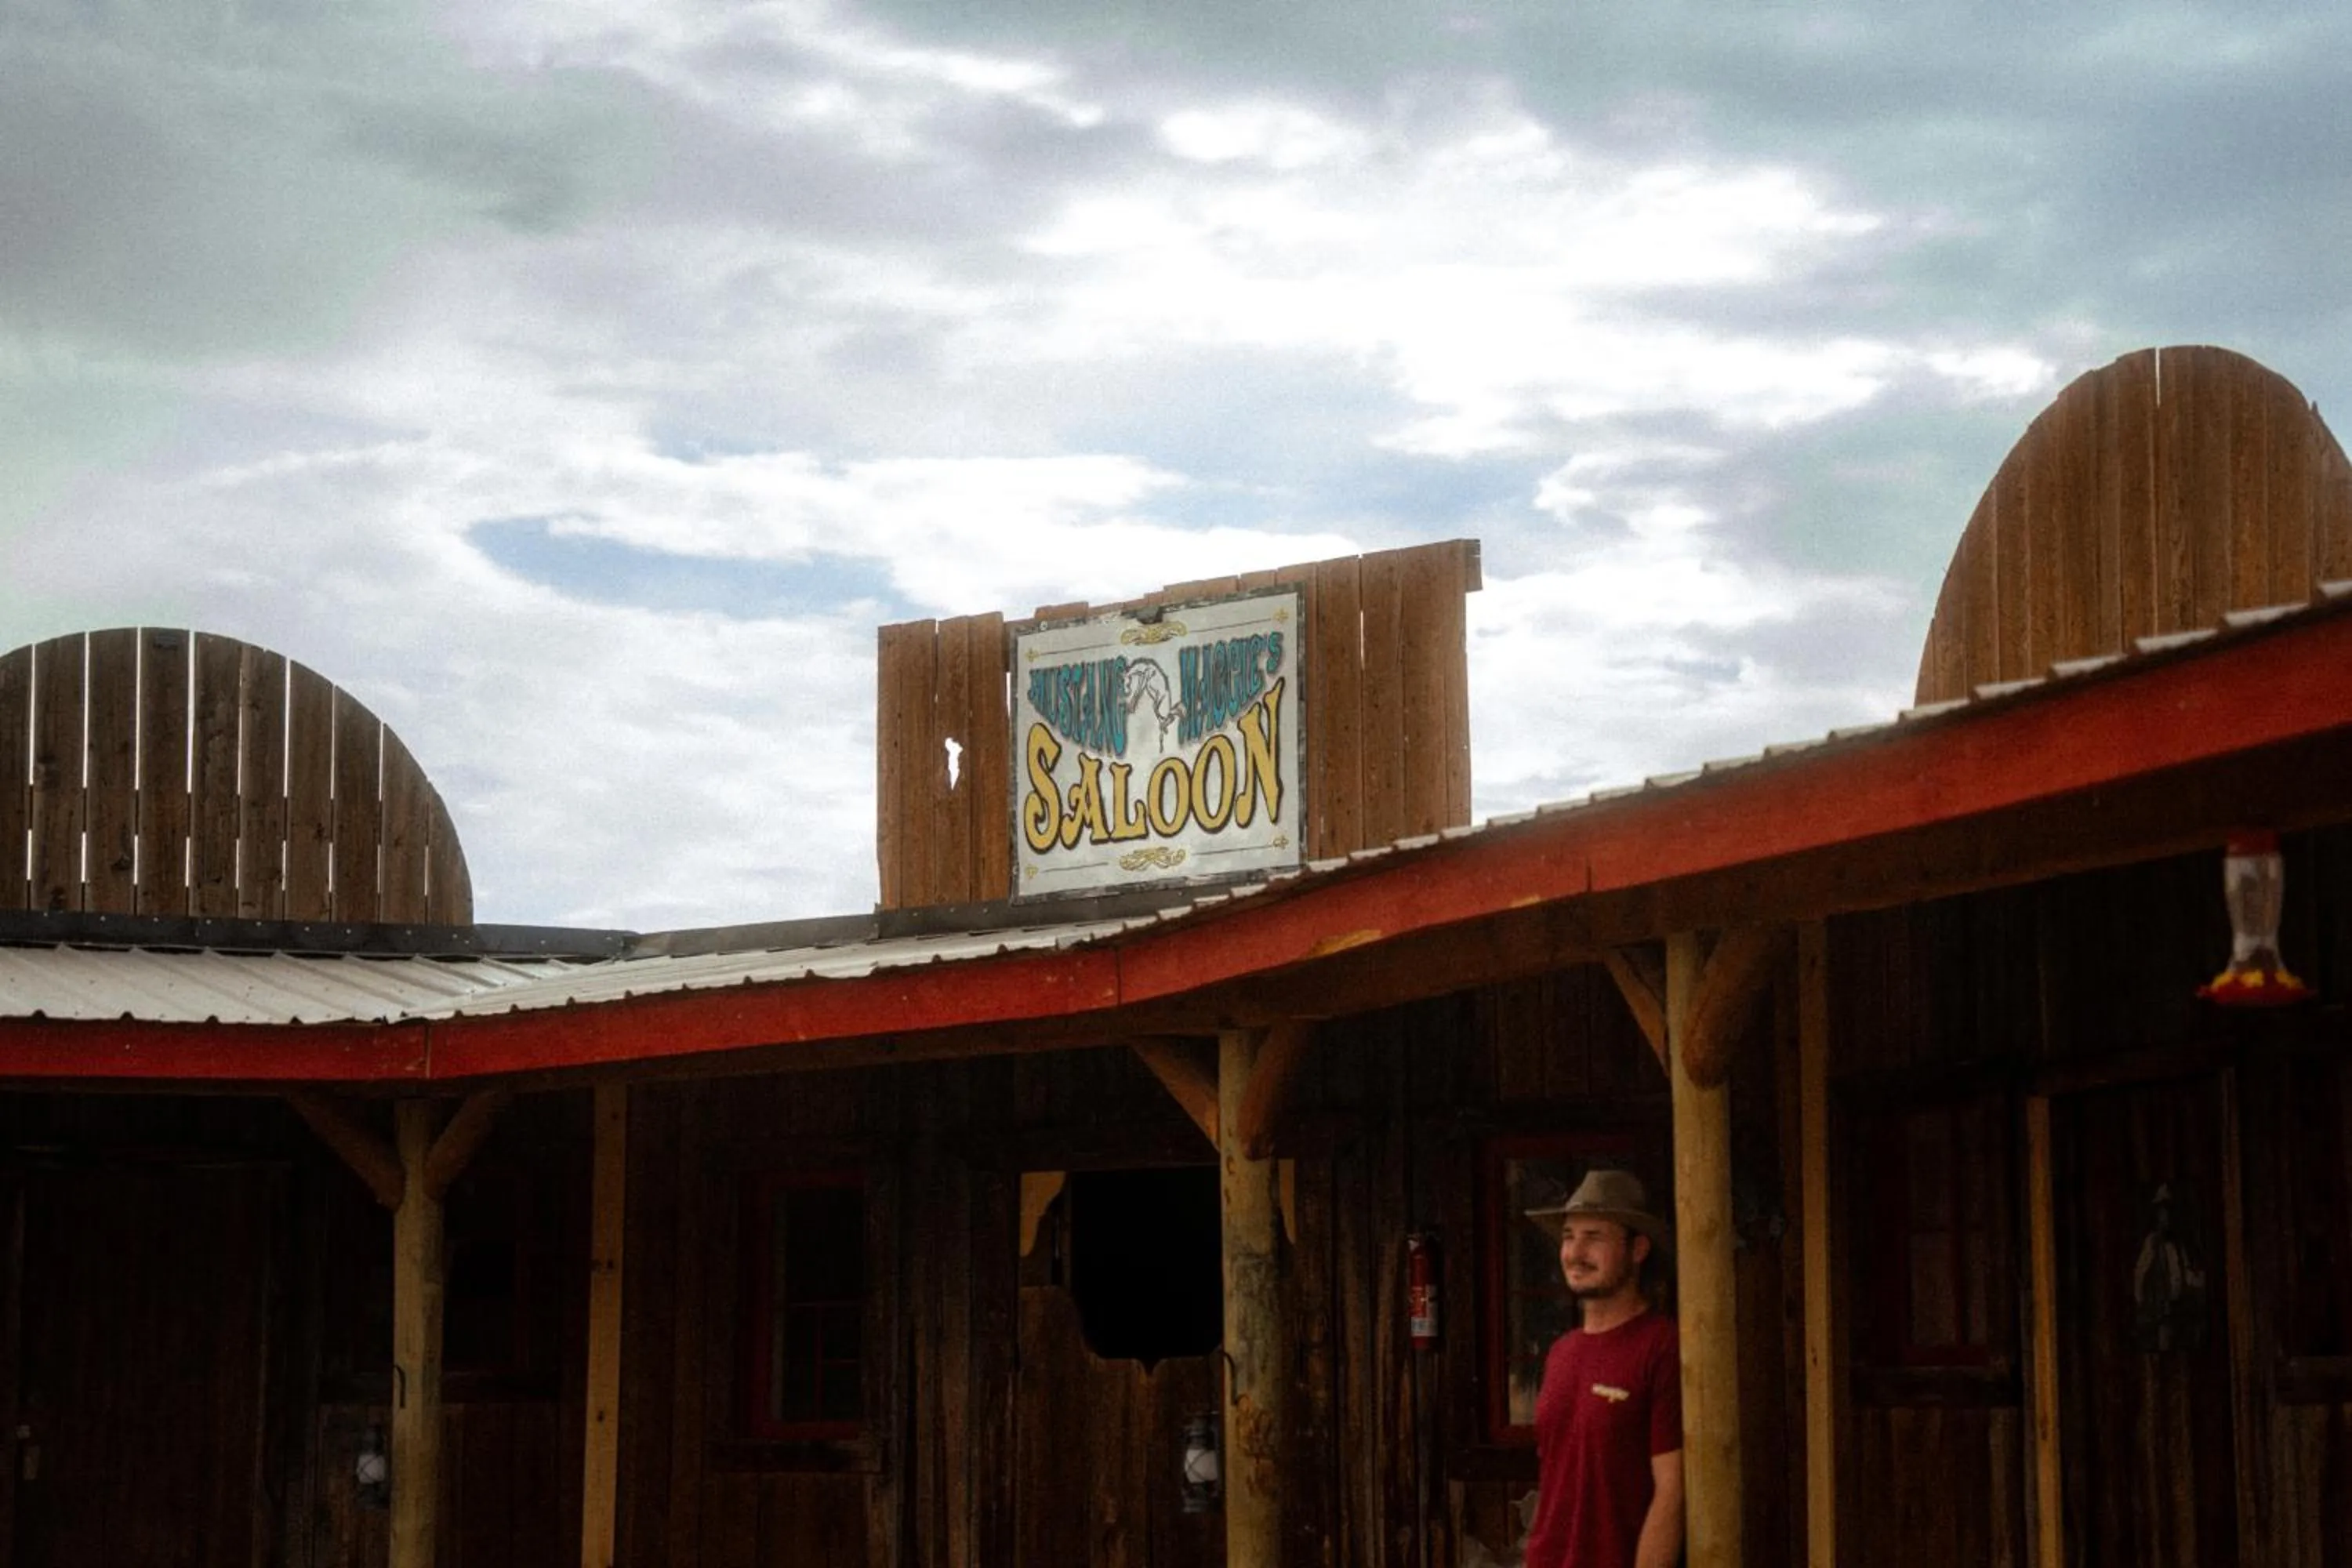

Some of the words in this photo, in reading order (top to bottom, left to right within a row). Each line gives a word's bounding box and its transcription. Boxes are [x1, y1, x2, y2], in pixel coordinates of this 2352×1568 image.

[1024, 677, 1286, 853] SALOON
[1027, 655, 1127, 756] MUSTANG
[1178, 631, 1283, 744] MAGGIE'S
